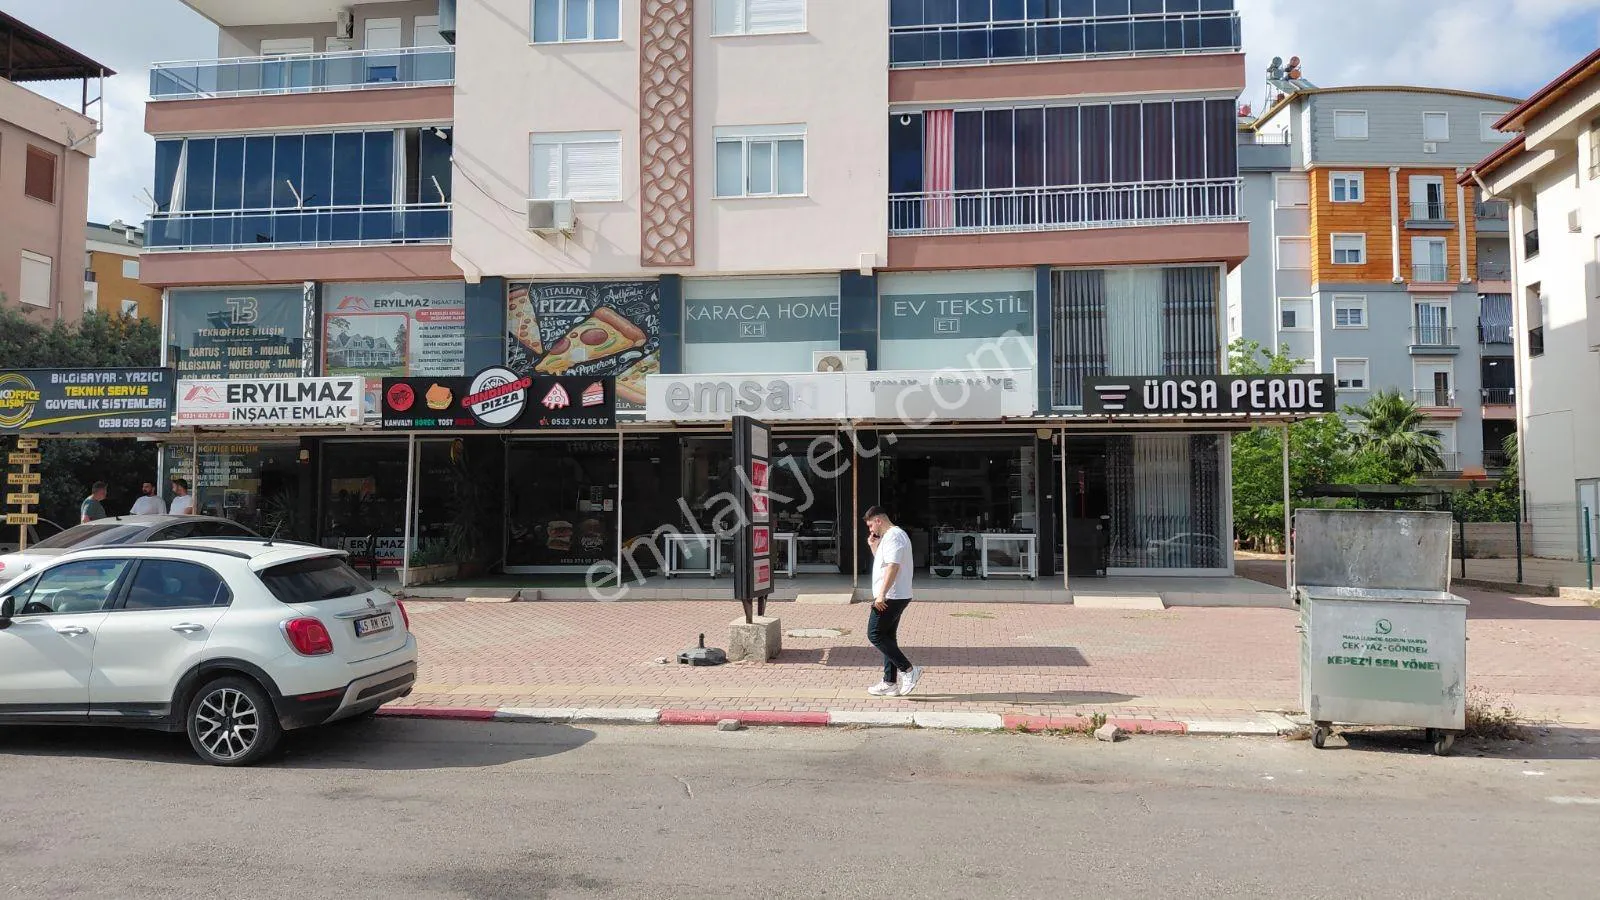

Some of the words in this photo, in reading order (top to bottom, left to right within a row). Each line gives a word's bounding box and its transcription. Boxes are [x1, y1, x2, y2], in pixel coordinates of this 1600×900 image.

[544, 287, 583, 296] ITALIAN
[374, 298, 429, 308] ERYILMAZ
[538, 299, 590, 313] PIZZA
[894, 300, 926, 317] EV
[936, 295, 1028, 315] TEKSTİL
[686, 304, 770, 321] KARACA
[778, 302, 840, 319] HOME
[744, 325, 764, 335] KH
[937, 321, 954, 331] ET
[188, 347, 220, 358] KARTUŞ
[227, 346, 252, 356] TONER
[260, 345, 290, 355] MUADİL
[178, 360, 221, 370] BİLGİSAYAR
[229, 360, 270, 369] NOTEBOOK
[576, 357, 617, 376] Pepperoni
[51, 373, 116, 384] BİLGİSAYAR
[125, 372, 162, 382] YAZICI
[65, 386, 105, 396] TEKNİK
[108, 386, 148, 396] SERVİS
[226, 382, 353, 403] ERYILMAZ
[1143, 379, 1217, 409] ÜNSA
[1231, 378, 1324, 408] PERDE
[45, 399, 100, 410] GÜVENLİK
[102, 399, 167, 409] SİSTEMLERİ
[481, 392, 520, 411] PIZZA
[232, 407, 288, 422] İNŞAAT
[293, 406, 346, 419] EMLAK
[141, 418, 153, 427] 50
[154, 418, 166, 427] 45
[350, 540, 404, 548] ERYLMAZ
[1376, 660, 1398, 668] SEN
[1402, 659, 1440, 670] YÖNET
